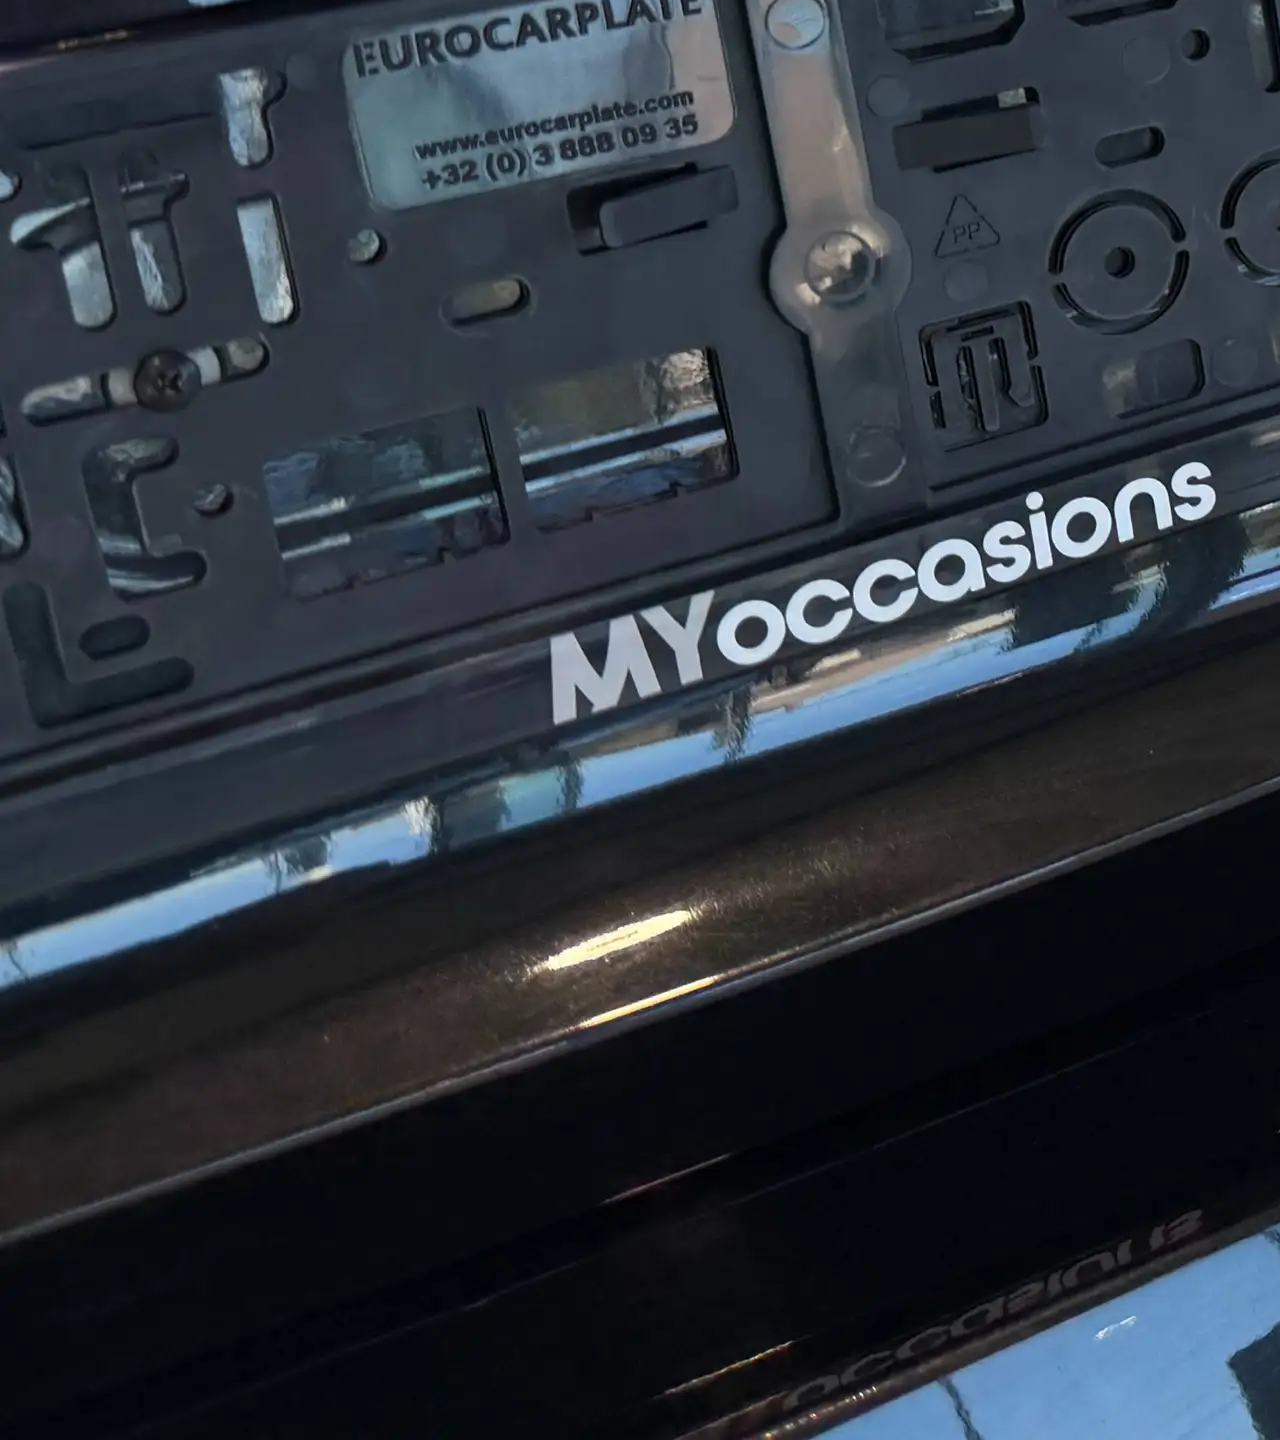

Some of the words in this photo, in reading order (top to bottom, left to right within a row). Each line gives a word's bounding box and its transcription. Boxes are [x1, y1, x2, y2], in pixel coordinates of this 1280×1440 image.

[415, 90, 695, 160] www.eurocarplate.com
[421, 159, 479, 190] +32
[485, 148, 528, 181] (0)
[532, 142, 557, 167] 3
[560, 133, 617, 162] 888
[622, 124, 658, 148] 09
[663, 113, 699, 139] 35
[551, 461, 1217, 726] MYoccasions
